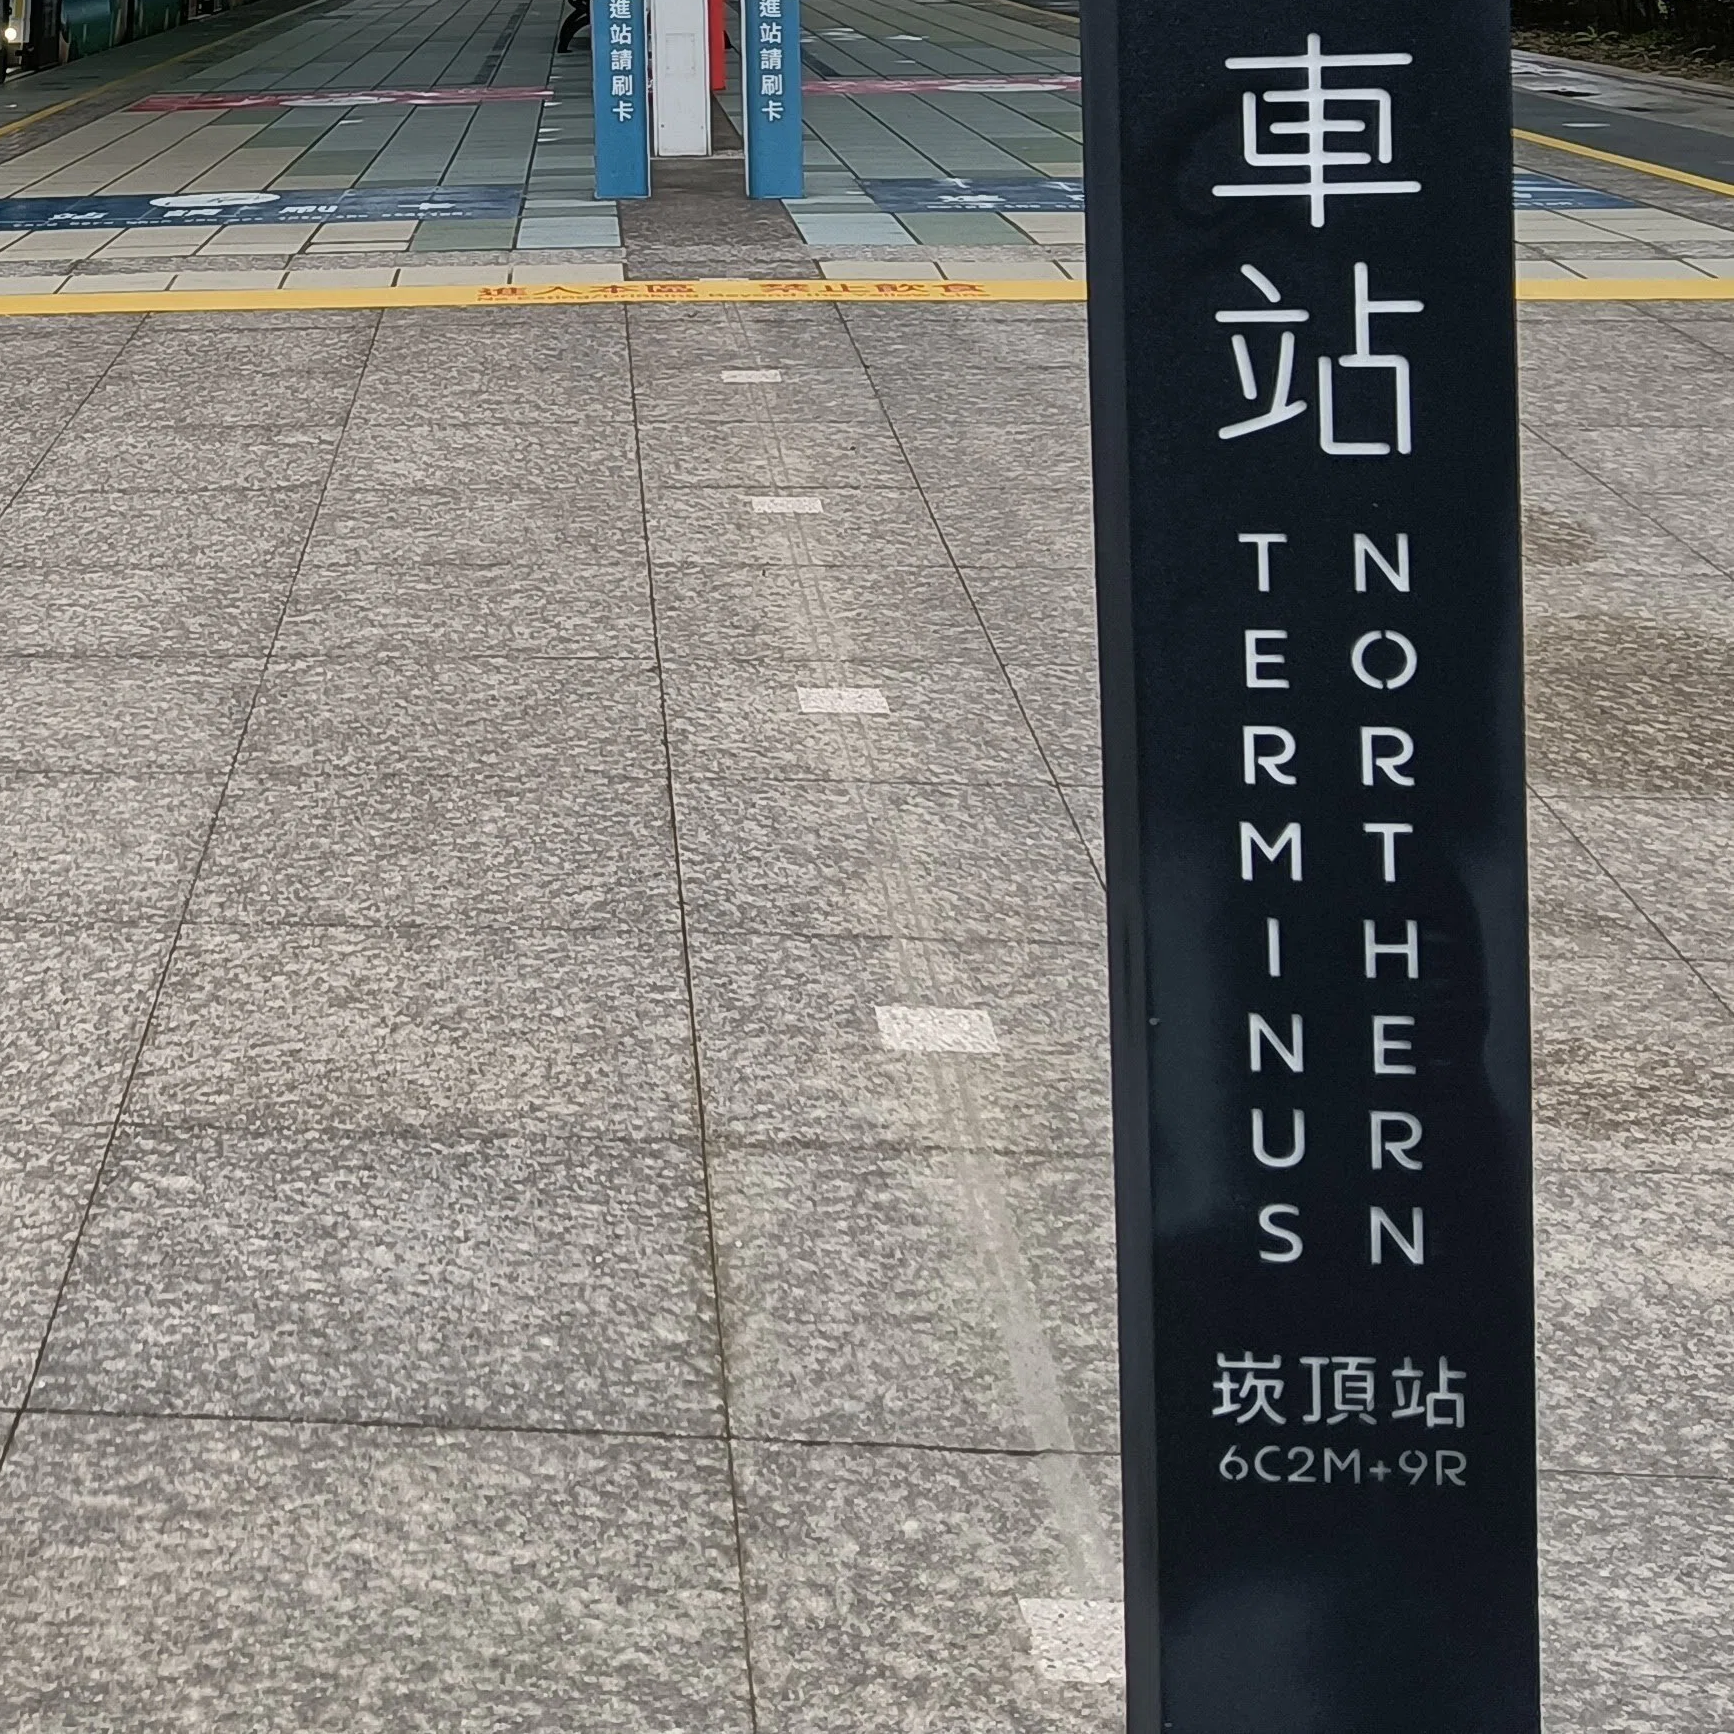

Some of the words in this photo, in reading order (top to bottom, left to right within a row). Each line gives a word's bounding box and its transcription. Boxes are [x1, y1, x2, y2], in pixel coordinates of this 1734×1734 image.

[1238, 533, 1306, 1265] TERMINUS
[1351, 533, 1425, 1266] NORTHERN
[1211, 1351, 1467, 1429] 崁頂站
[1218, 1445, 1467, 1487] 6C2M+9R
